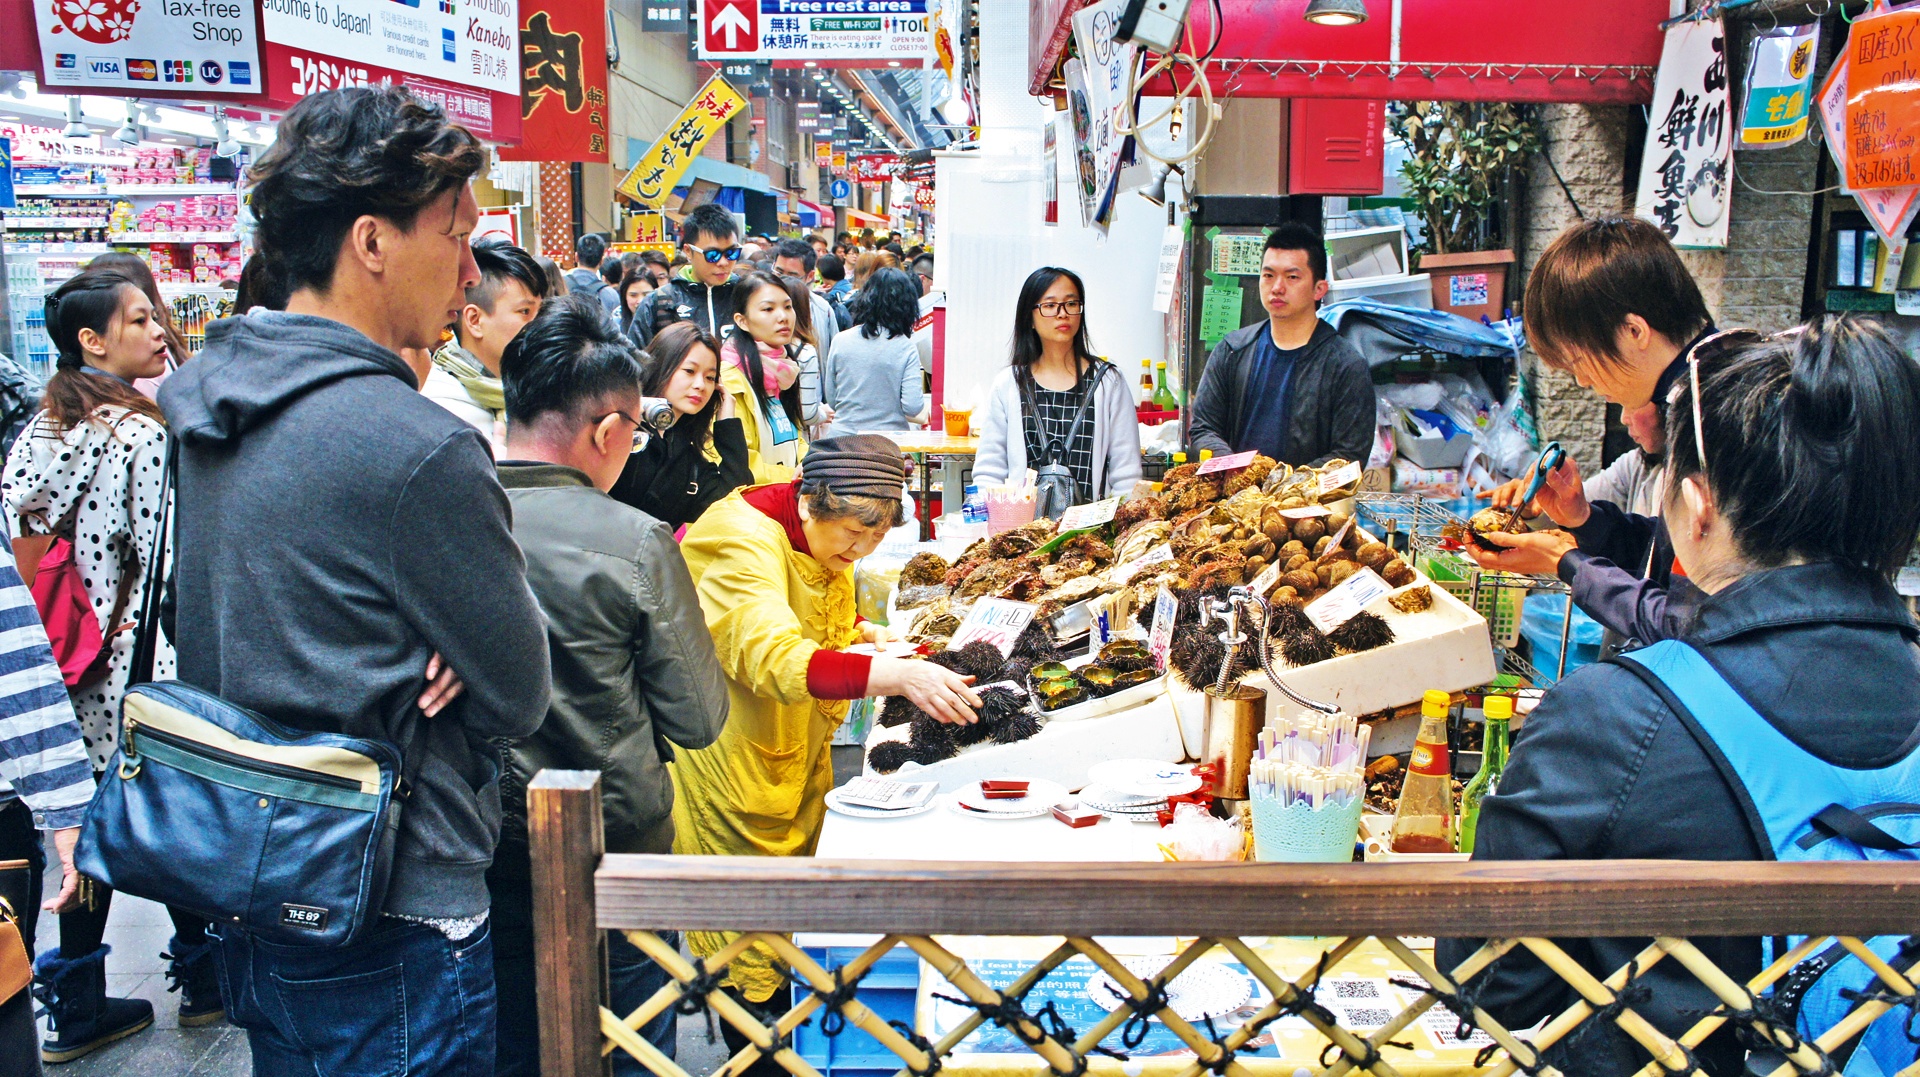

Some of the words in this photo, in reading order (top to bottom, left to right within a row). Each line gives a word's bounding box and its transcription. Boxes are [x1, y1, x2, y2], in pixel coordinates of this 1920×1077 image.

[162, 0, 241, 18] Tax-free
[779, 0, 823, 12] Free
[826, 1, 864, 12] rest
[867, 1, 912, 12] area
[315, 1, 328, 24] to
[332, 4, 372, 35] Japan!
[824, 20, 841, 29] FREE
[862, 20, 879, 29] SPOT
[770, 18, 800, 33] 無料
[193, 21, 243, 46] Shop
[466, 16, 511, 51] Kanebo
[839, 34, 861, 43] eating
[862, 35, 883, 43] space
[762, 34, 809, 49] 休憩所
[91, 61, 120, 74] VISA
[128, 65, 156, 75] MasterCard
[163, 66, 193, 77] JCB
[470, 48, 508, 82] 雪肌精
[202, 66, 222, 79] UC
[945, 412, 967, 422] SPOON
[288, 909, 306, 920] THE
[305, 911, 320, 922] 89
